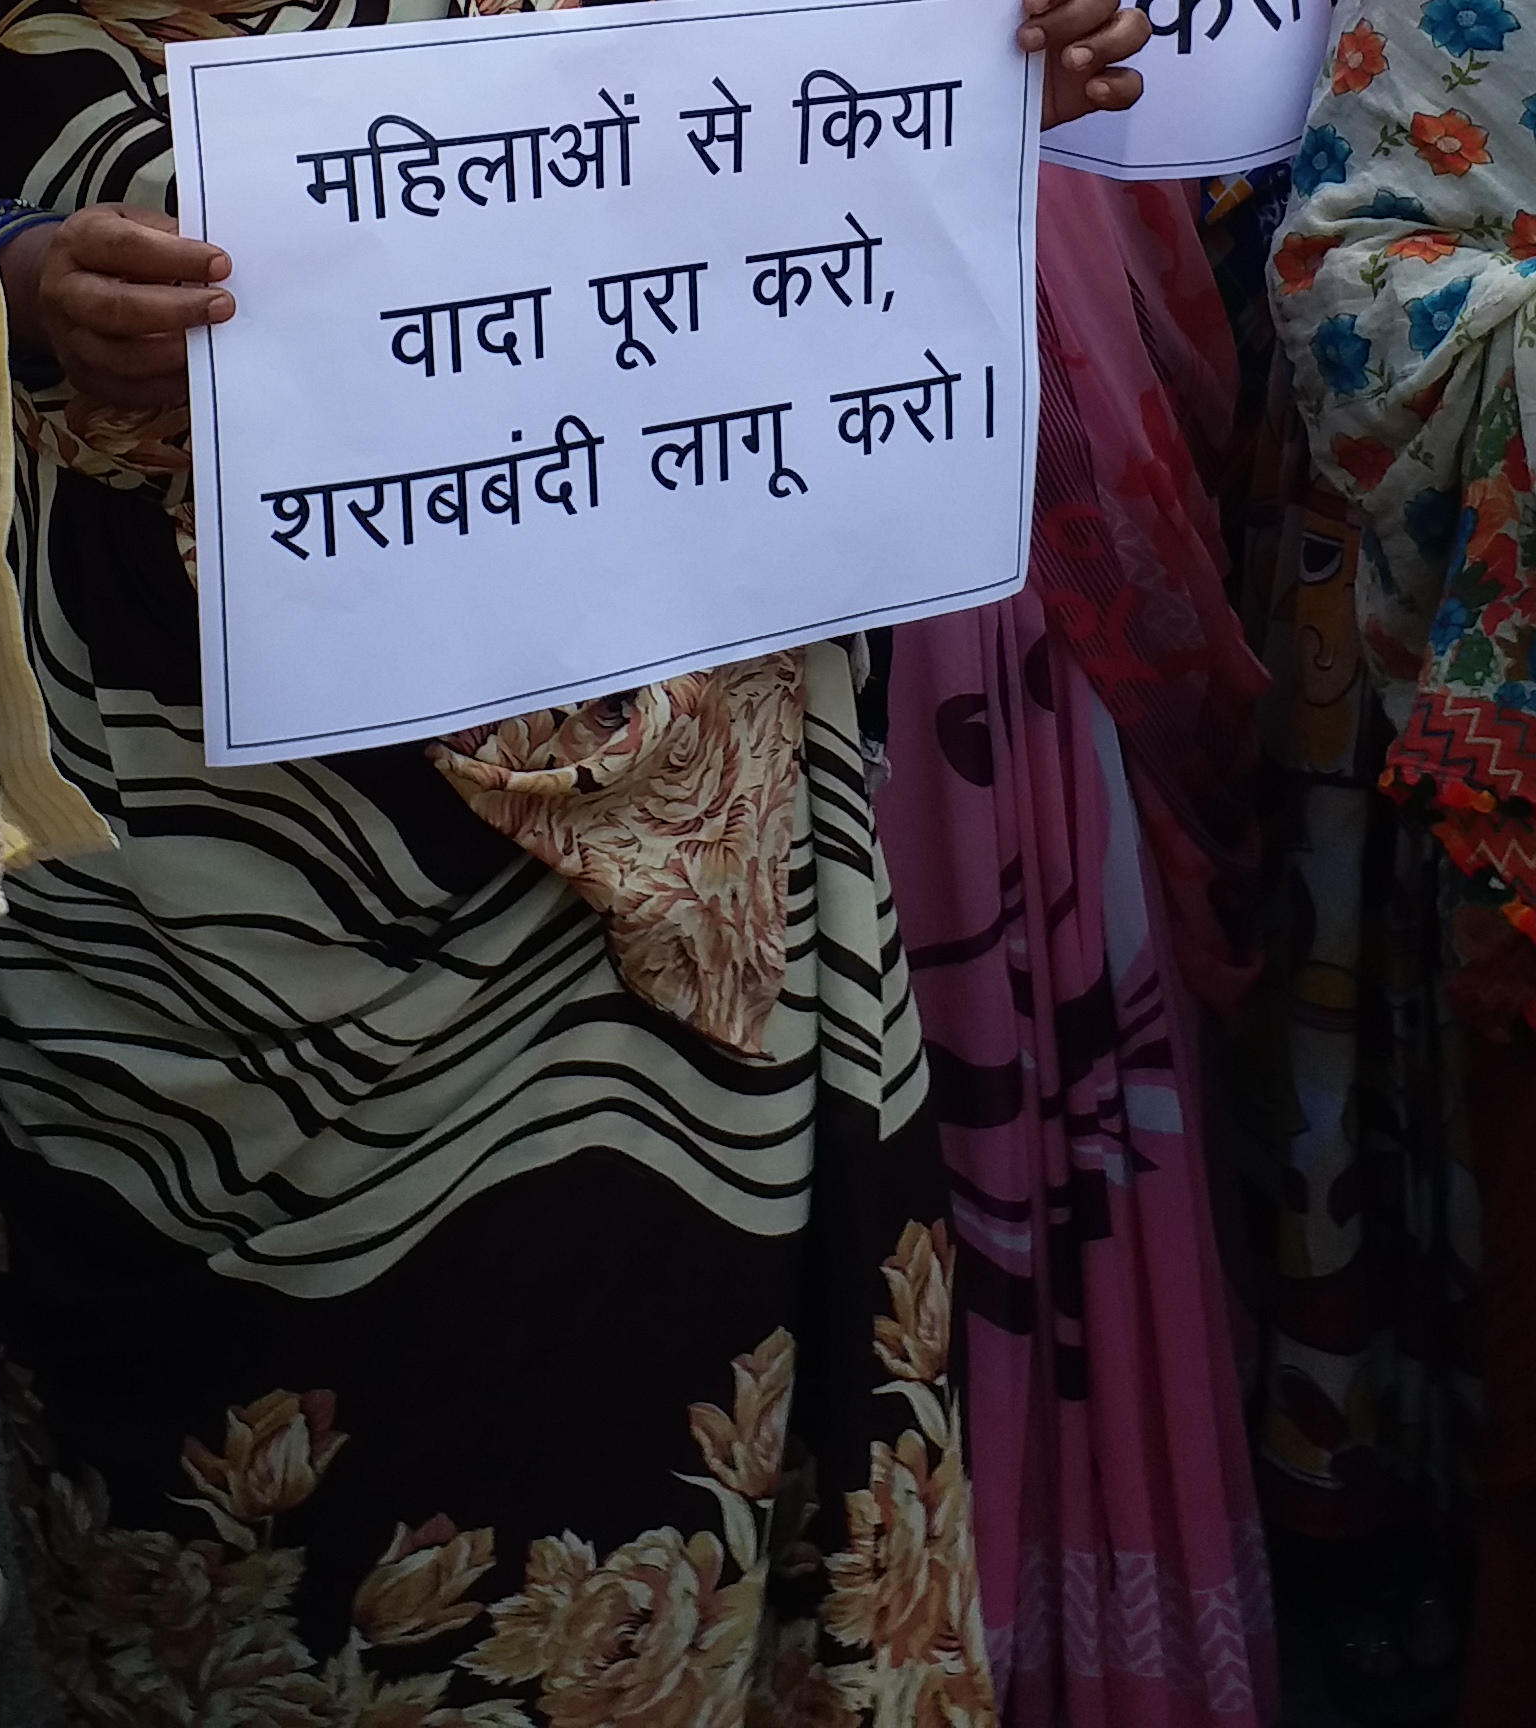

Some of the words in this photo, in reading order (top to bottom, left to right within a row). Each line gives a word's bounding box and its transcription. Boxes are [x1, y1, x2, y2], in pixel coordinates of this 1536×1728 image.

[297, 88, 639, 222] महिलाओं
[680, 77, 751, 175] से
[793, 70, 962, 164] किया
[380, 287, 551, 377] वादा
[589, 262, 708, 370] पूरा
[746, 212, 894, 317] करो,
[261, 415, 604, 560] शराबबंदी
[642, 402, 808, 498] लागू
